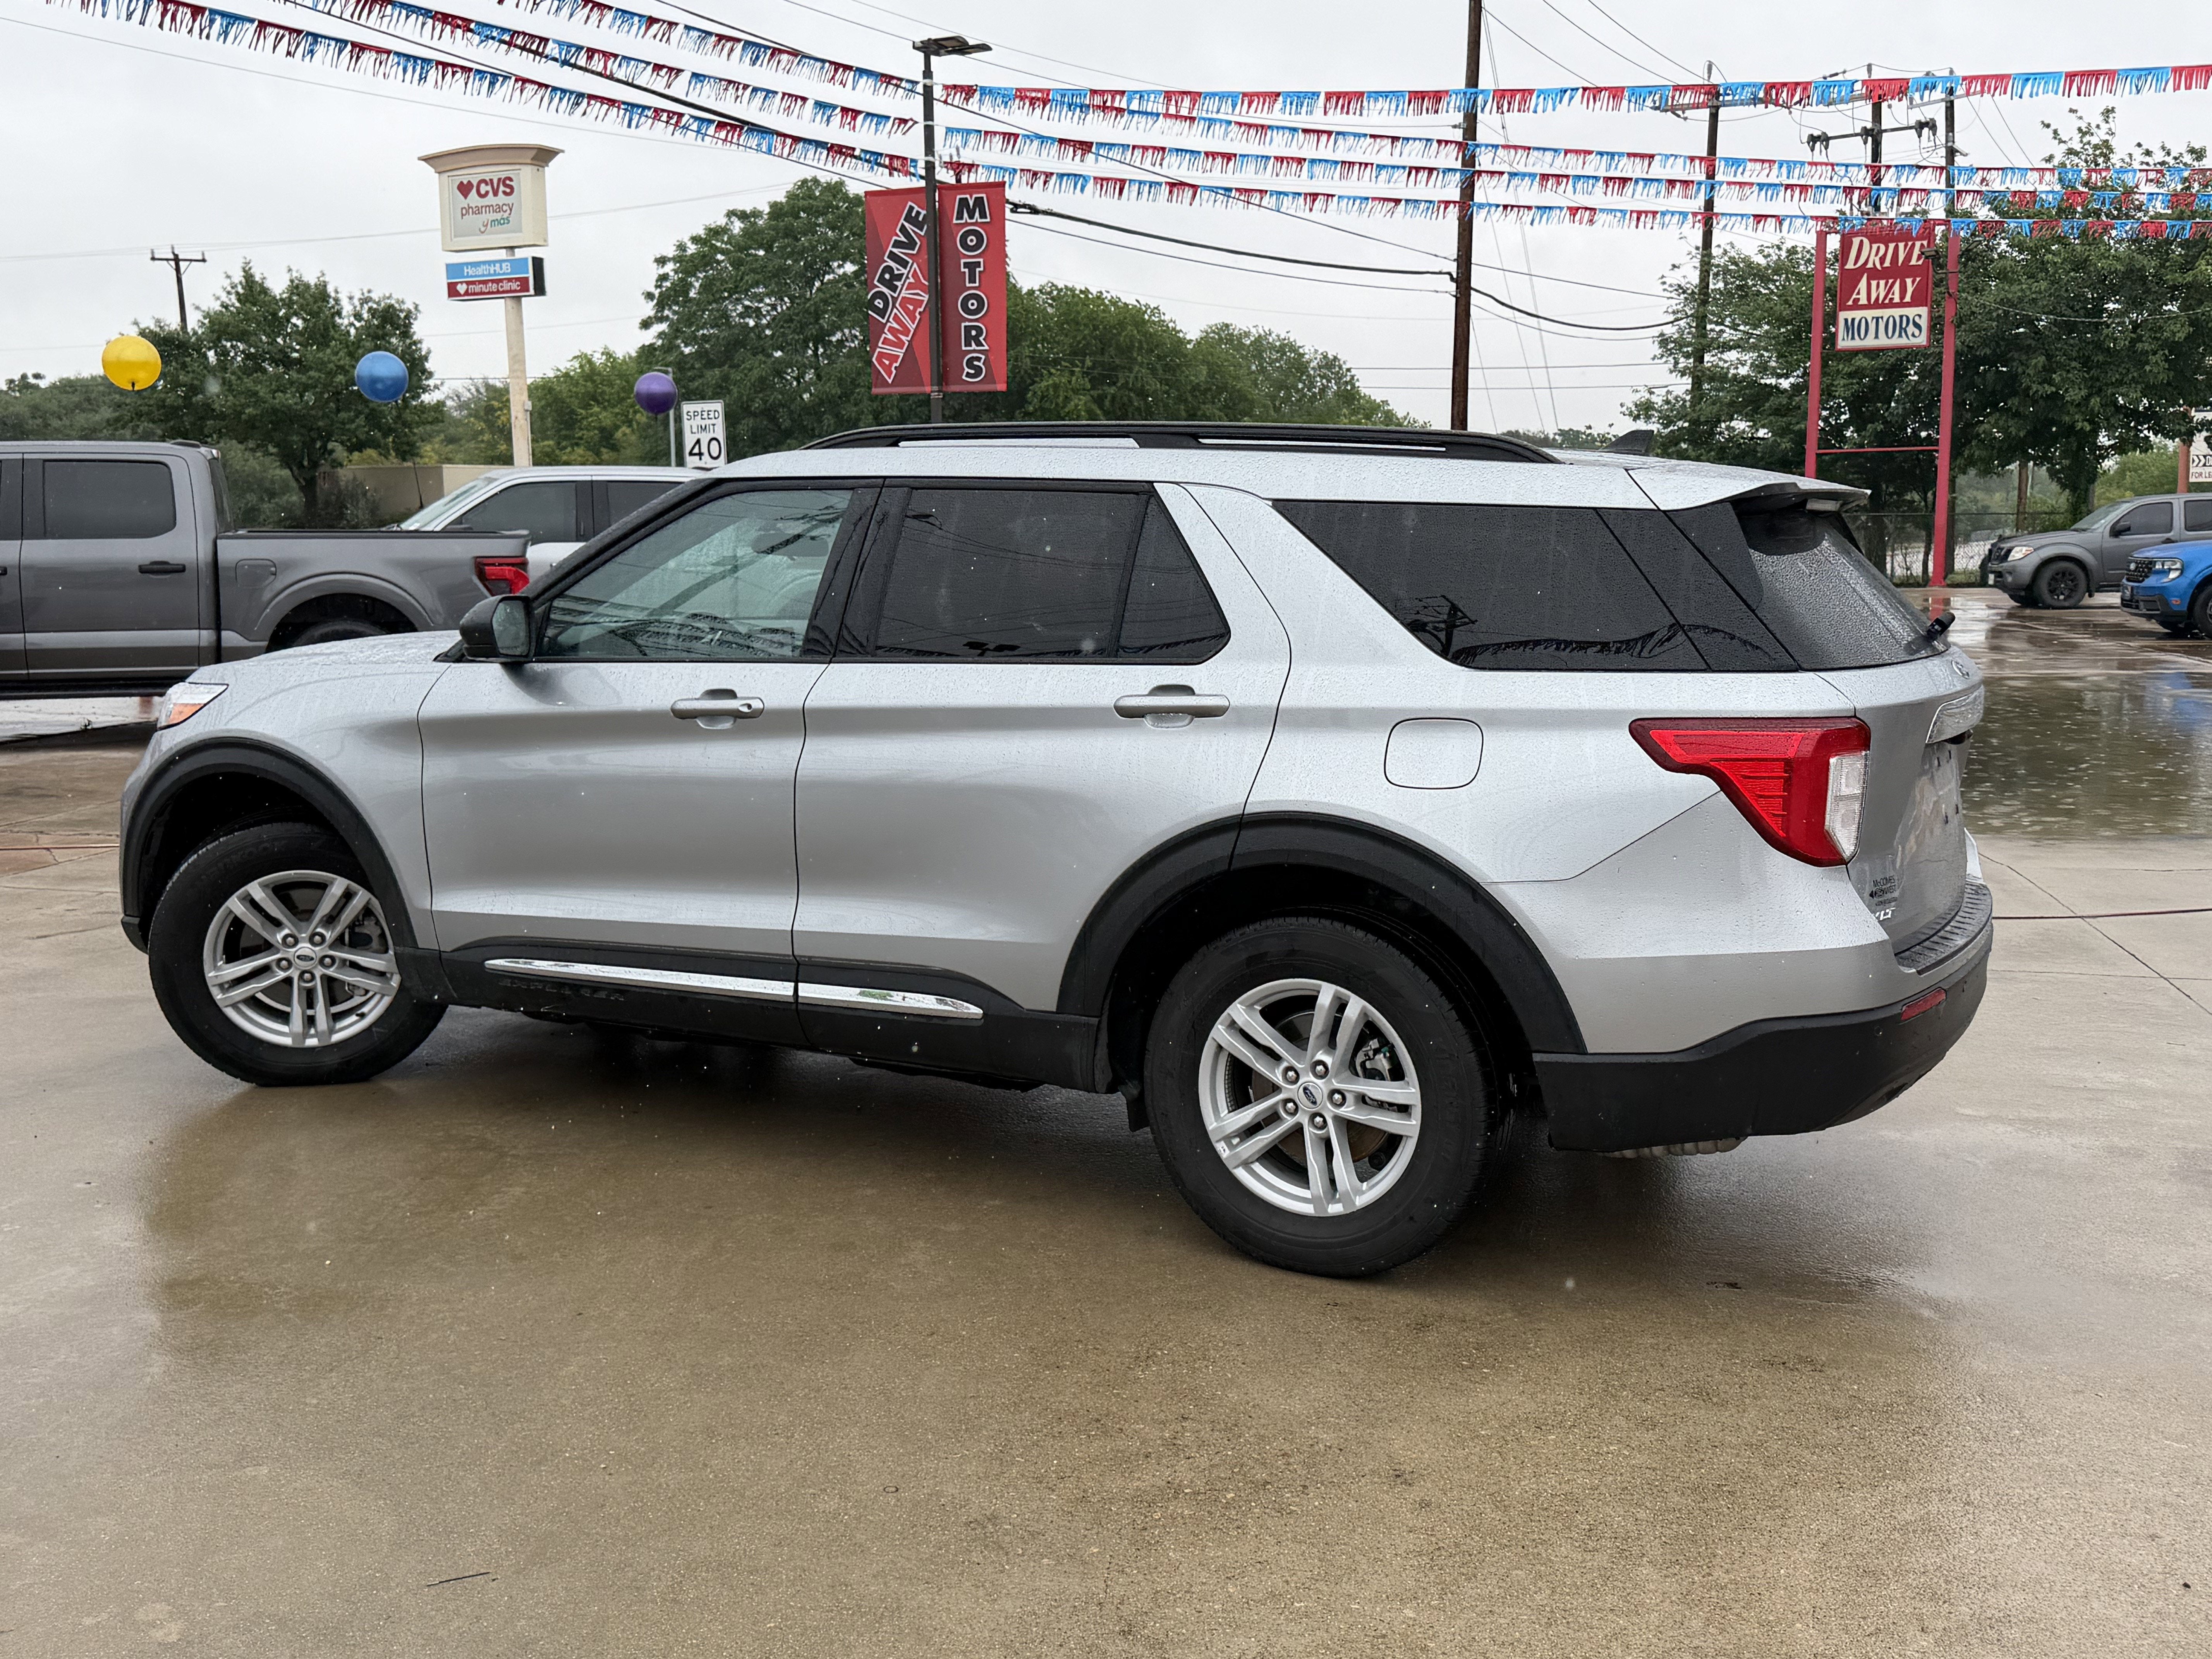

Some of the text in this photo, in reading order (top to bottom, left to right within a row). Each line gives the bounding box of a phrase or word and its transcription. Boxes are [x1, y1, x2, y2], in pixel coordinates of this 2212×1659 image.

[476, 176, 515, 199] CVS
[461, 203, 514, 220] pharmacy
[479, 215, 510, 234] y más
[868, 201, 927, 323] DRIVE
[1844, 236, 1928, 270] DRIVE
[464, 262, 511, 276] HealthHUB
[469, 279, 520, 294] minute clinic
[953, 194, 990, 382] MOTORS
[1846, 273, 1922, 306] AWAY
[872, 262, 929, 384] AWAY
[1842, 314, 1922, 342] MOTORS
[686, 410, 720, 421] SPEED
[690, 424, 716, 434] LIMIT
[689, 437, 721, 460] 40
